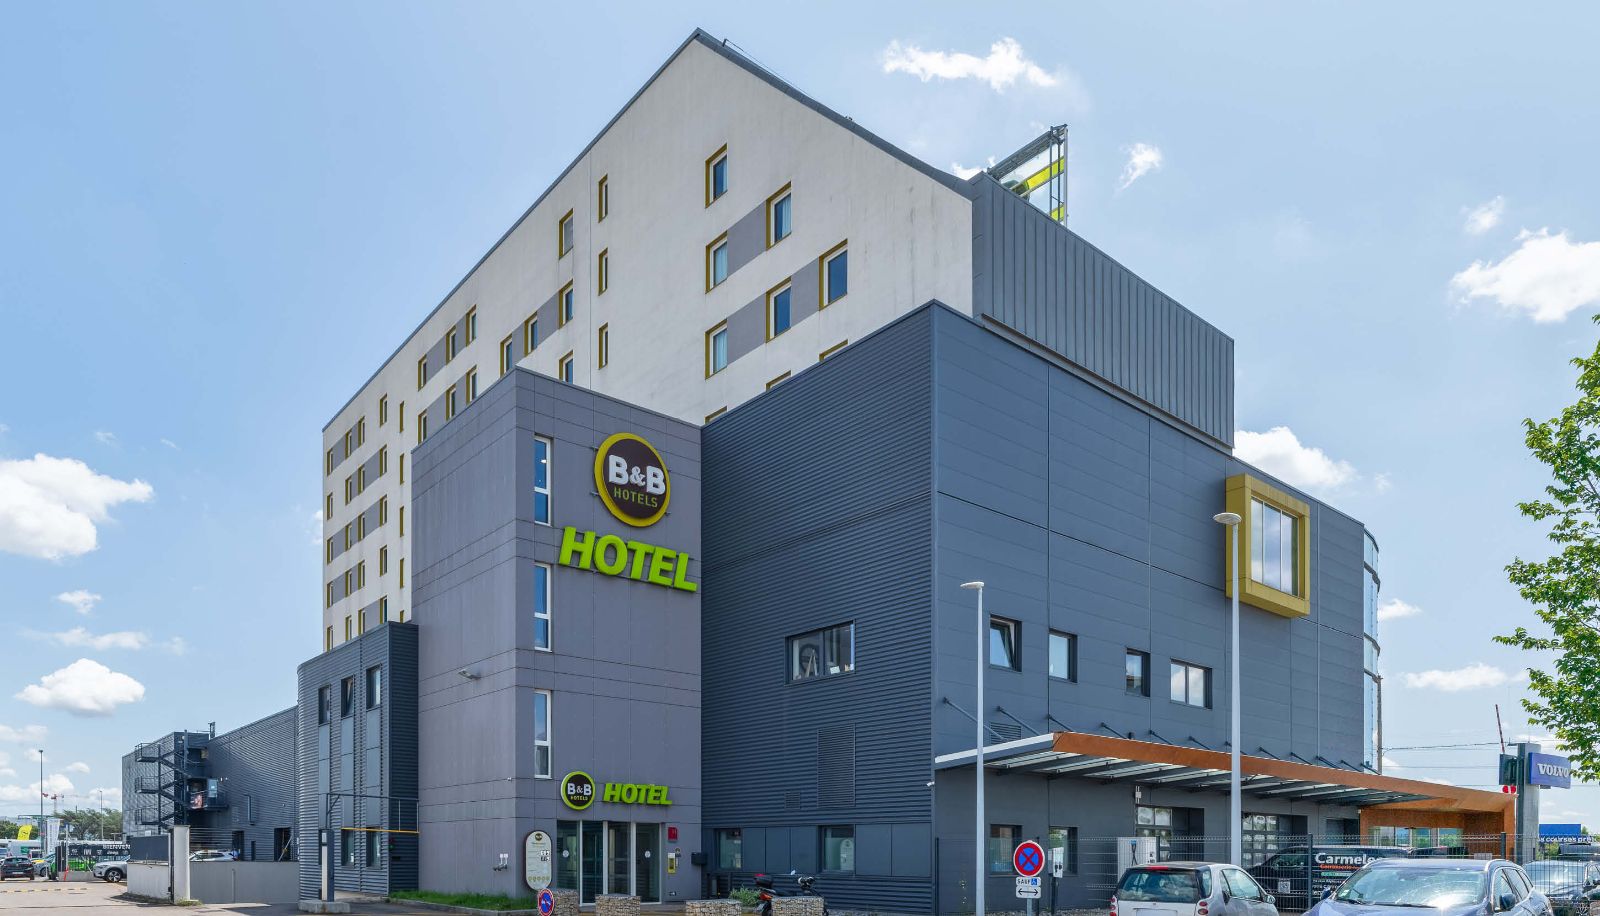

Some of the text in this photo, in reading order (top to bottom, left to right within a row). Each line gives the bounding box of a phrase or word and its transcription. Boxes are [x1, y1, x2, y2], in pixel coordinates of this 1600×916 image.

[608, 454, 666, 495] B&B
[613, 486, 658, 508] HOTELS
[559, 526, 698, 592] HOTEL
[1537, 763, 1569, 778] VOLVO
[567, 783, 592, 796] B&B
[603, 783, 673, 805] HOTEL
